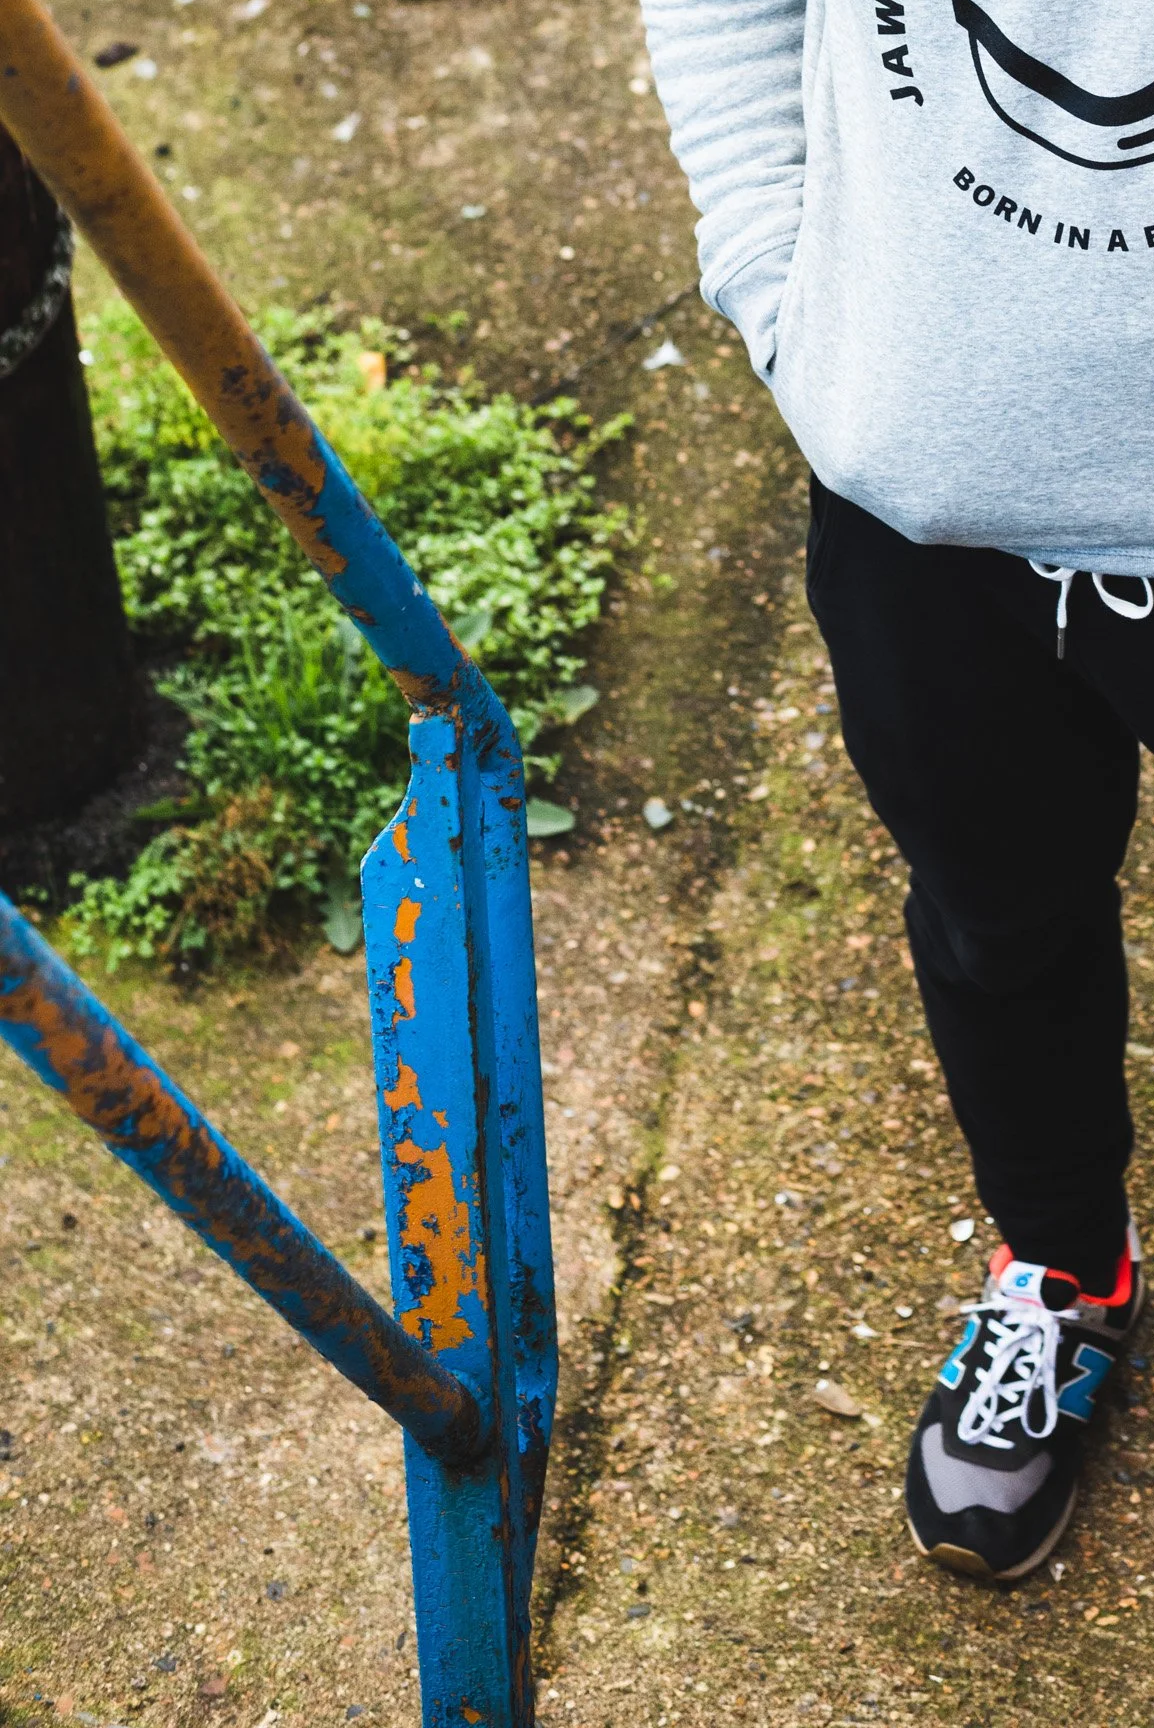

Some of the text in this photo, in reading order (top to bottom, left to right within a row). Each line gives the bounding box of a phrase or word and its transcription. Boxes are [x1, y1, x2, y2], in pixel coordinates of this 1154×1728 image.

[952, 166, 1043, 235] BORN
[1053, 221, 1091, 251] IN
[1107, 229, 1130, 252] A
